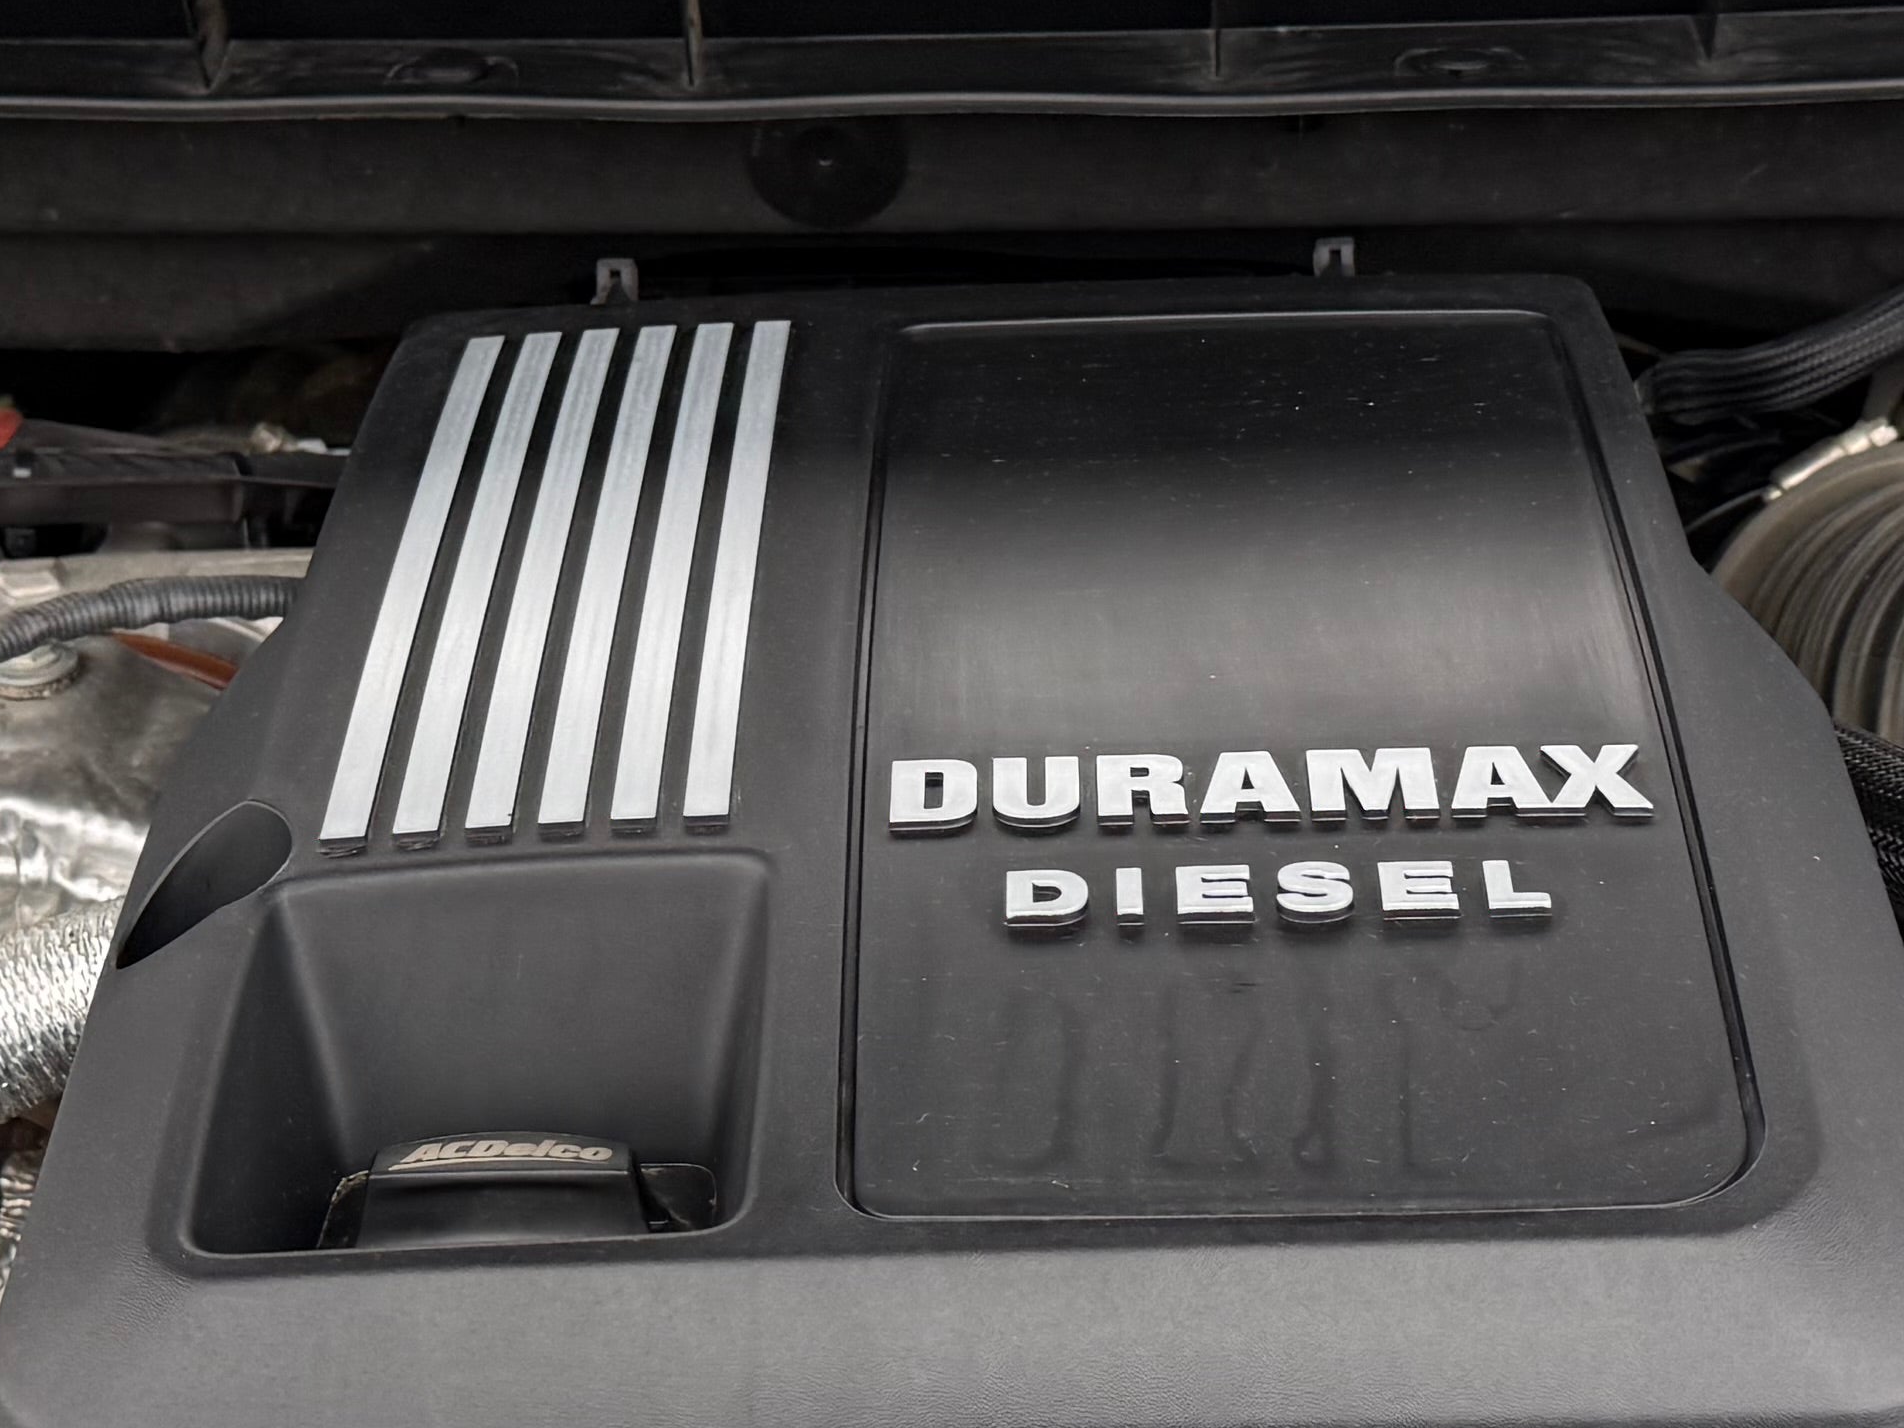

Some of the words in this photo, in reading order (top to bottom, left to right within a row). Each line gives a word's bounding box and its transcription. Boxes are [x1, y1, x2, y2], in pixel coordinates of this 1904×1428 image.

[887, 743, 1655, 833] DURAMAX
[1003, 858, 1554, 928] DIESEL
[399, 1138, 613, 1163] ACDelco
